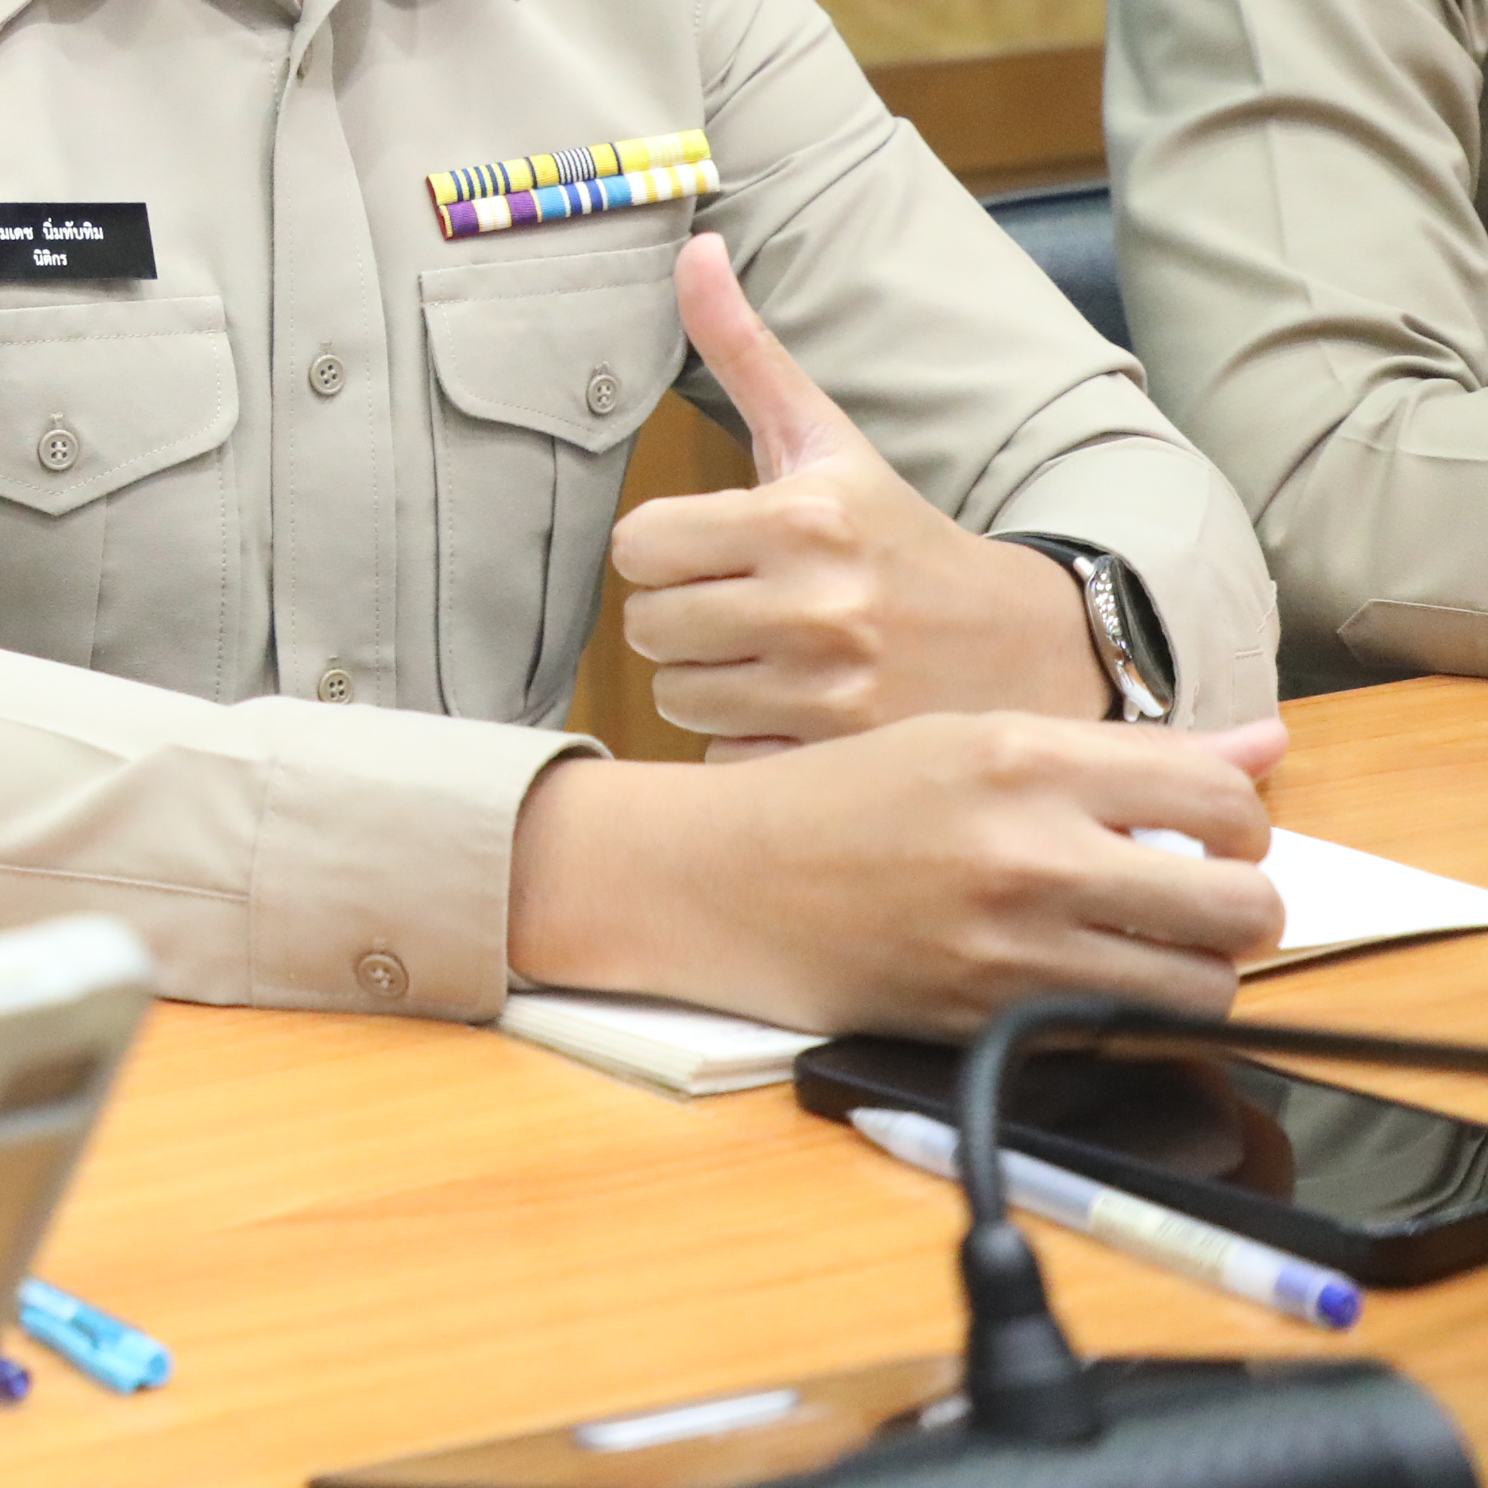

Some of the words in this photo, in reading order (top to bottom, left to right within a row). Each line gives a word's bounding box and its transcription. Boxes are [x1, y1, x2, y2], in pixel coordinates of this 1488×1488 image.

[42, 217, 104, 240] นิ่มทับทิม
[33, 248, 68, 266] นิติกร
